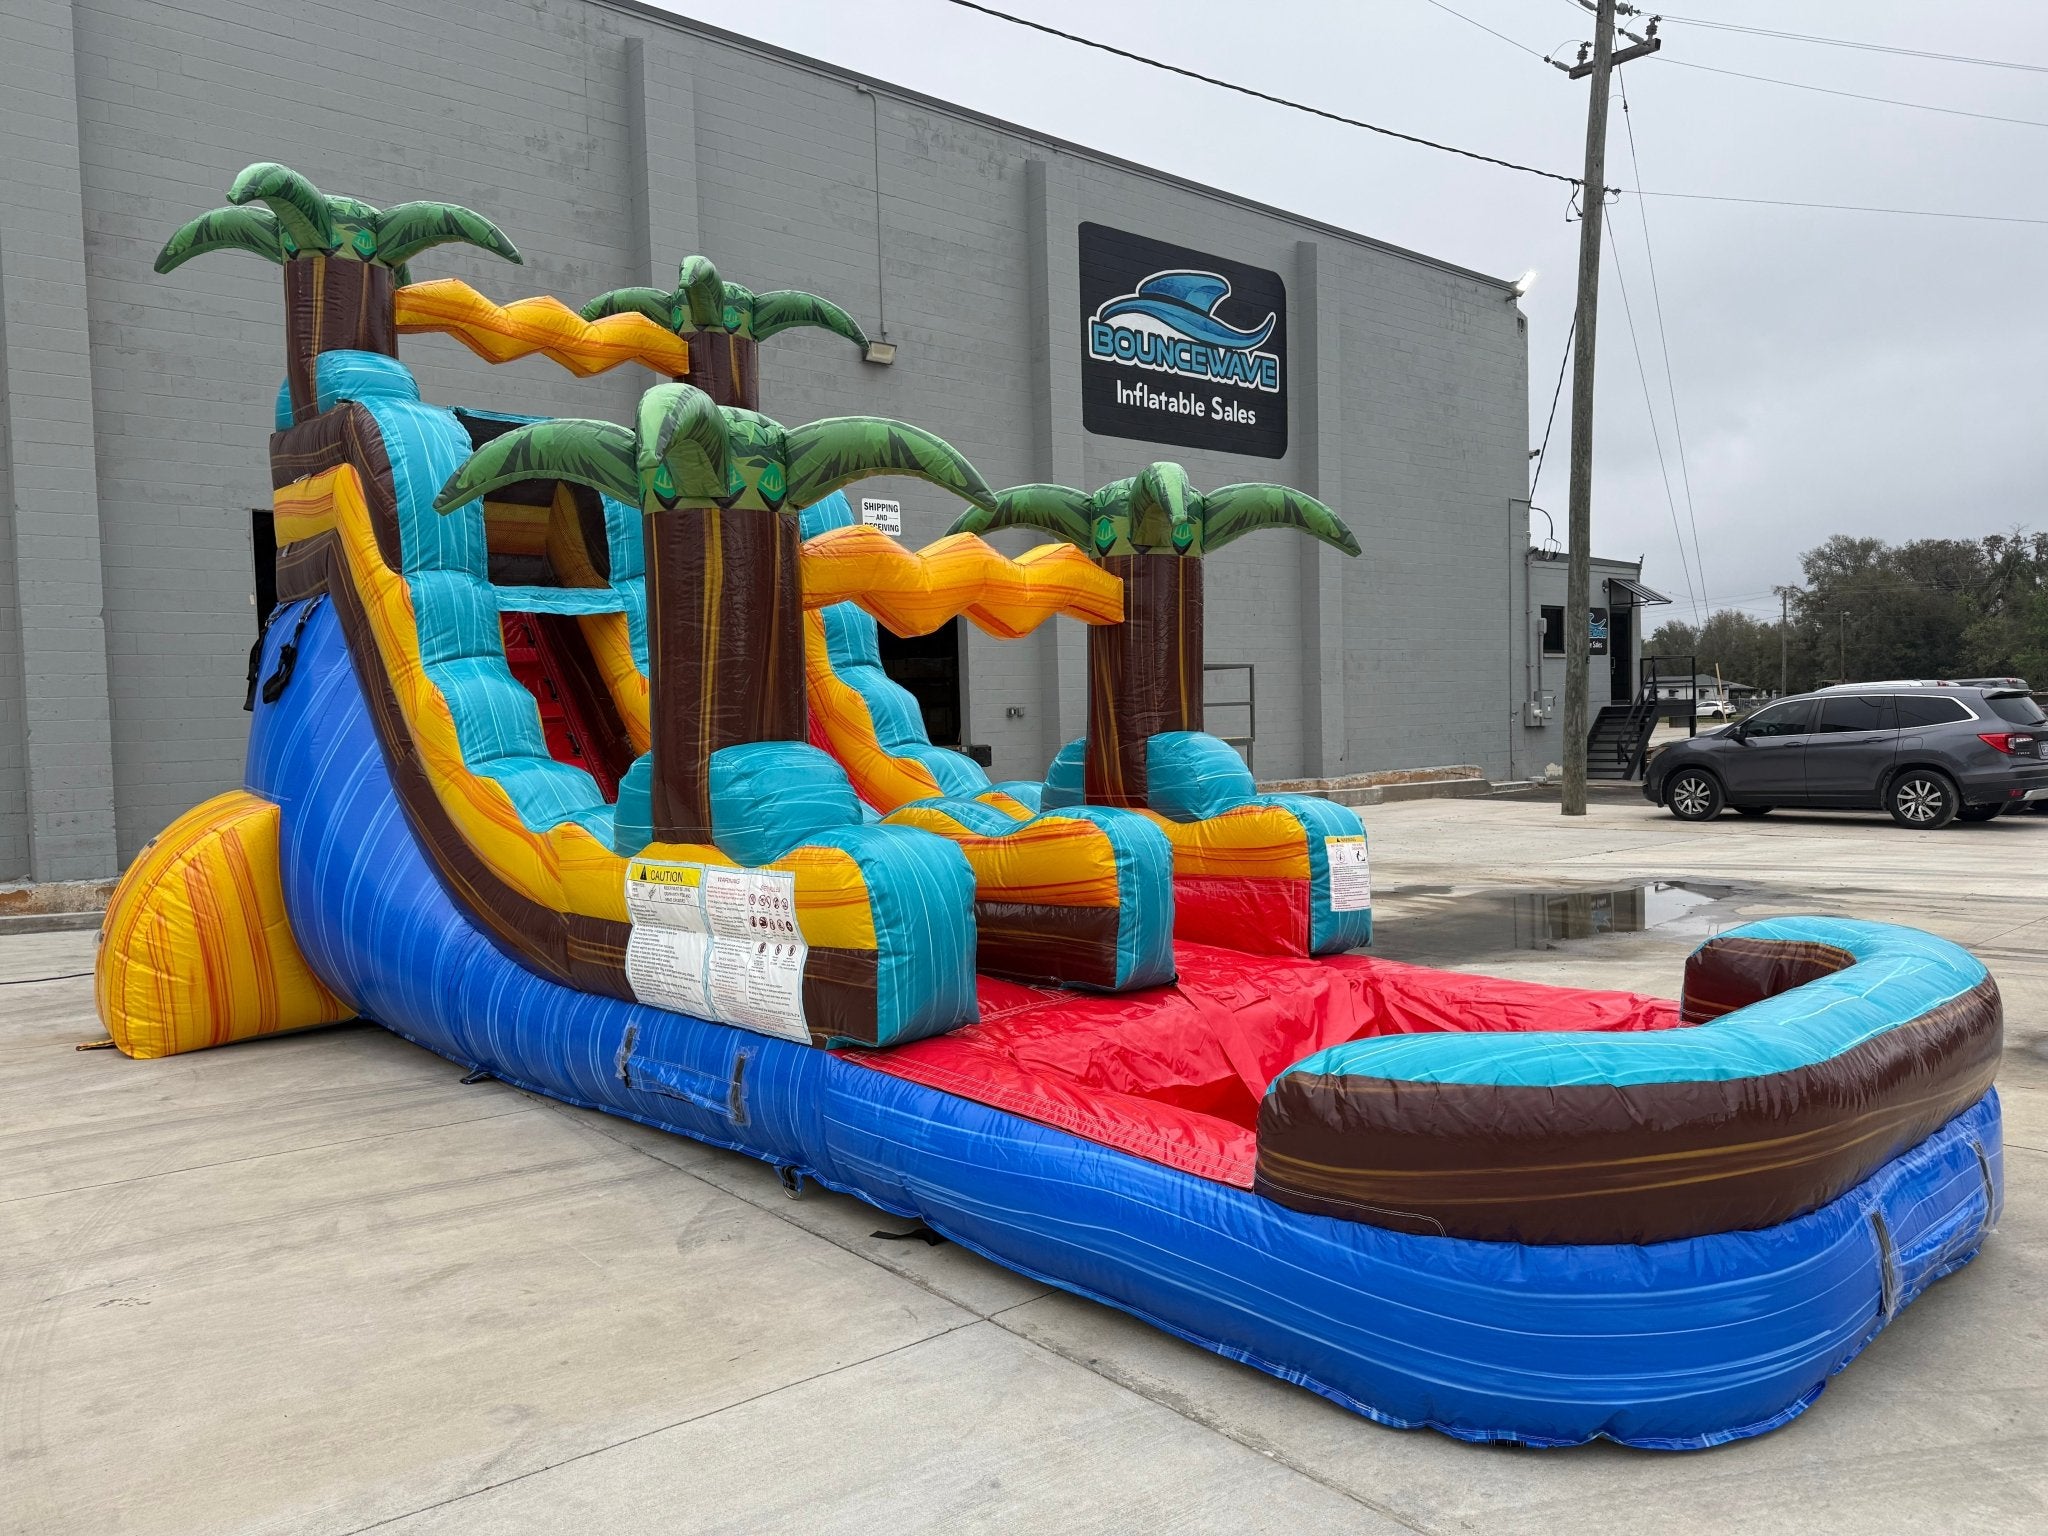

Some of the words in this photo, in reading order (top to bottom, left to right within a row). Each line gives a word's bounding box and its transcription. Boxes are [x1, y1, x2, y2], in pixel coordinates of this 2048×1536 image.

[1091, 322, 1277, 388] BOUNCEWAVE
[1116, 380, 1206, 417] Inflatable
[1211, 396, 1256, 425] Sales
[864, 502, 898, 512] SHIPPING
[650, 869, 684, 882] CAUTION
